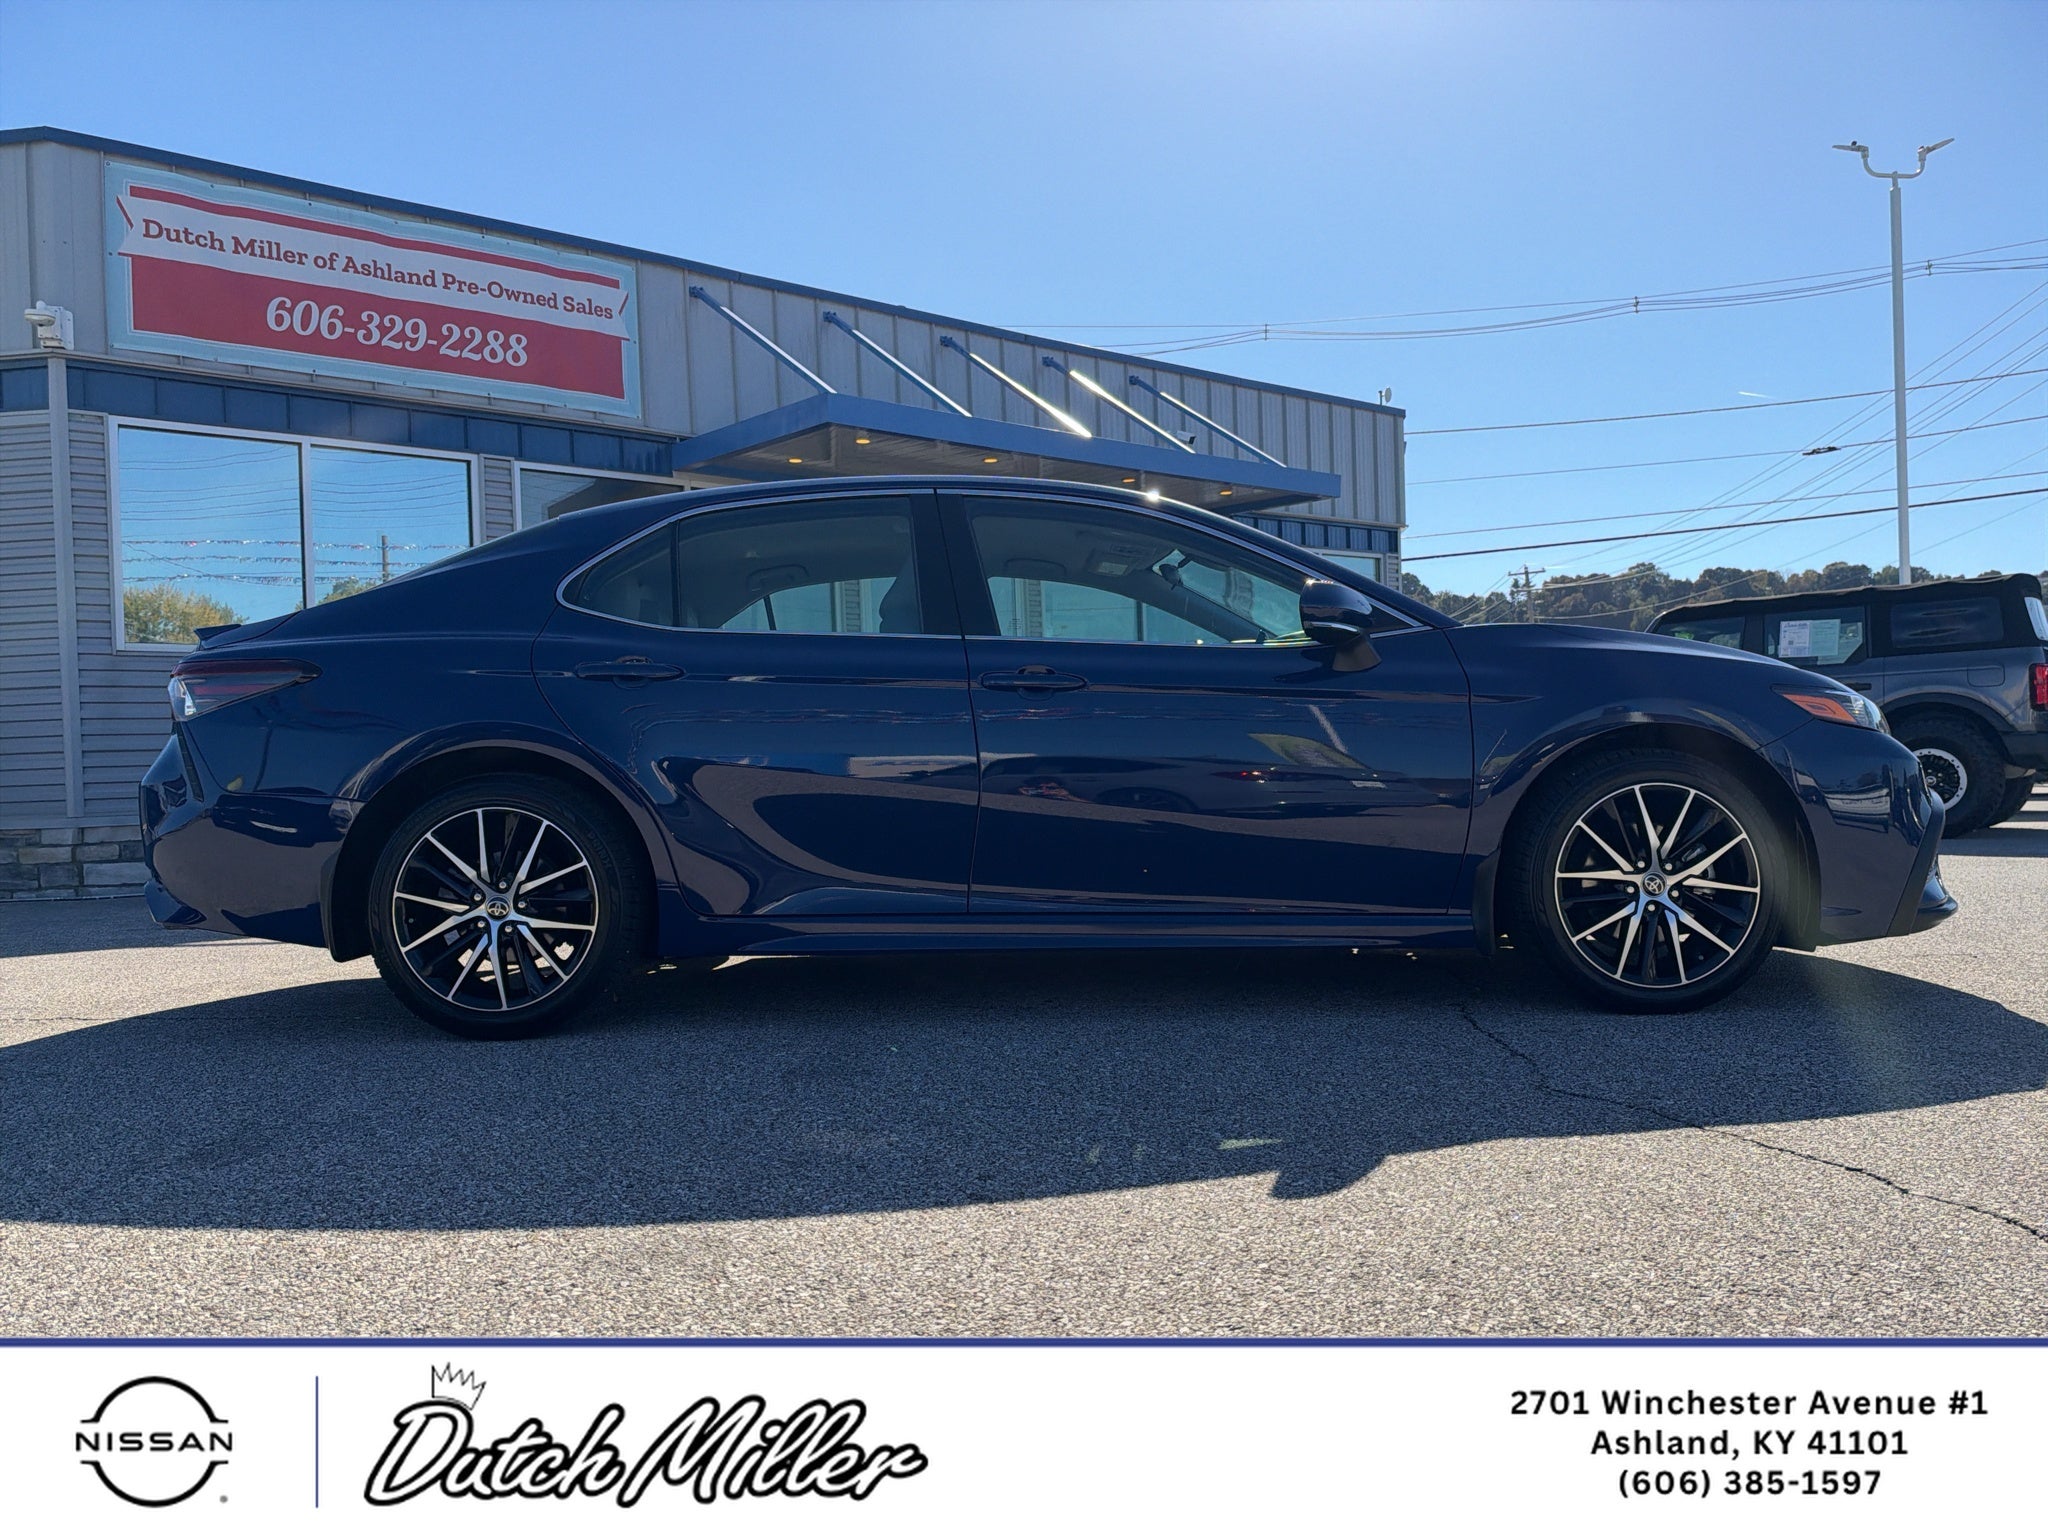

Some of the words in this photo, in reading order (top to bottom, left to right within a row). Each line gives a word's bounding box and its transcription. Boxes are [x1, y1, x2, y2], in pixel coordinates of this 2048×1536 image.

[142, 218, 225, 253] Dutch
[231, 236, 309, 266] Miller
[313, 251, 339, 272] of
[342, 255, 437, 288] Ashland
[442, 272, 559, 311] Pre-Owned
[562, 294, 614, 321] Sales
[266, 296, 529, 368] 606-329-2288
